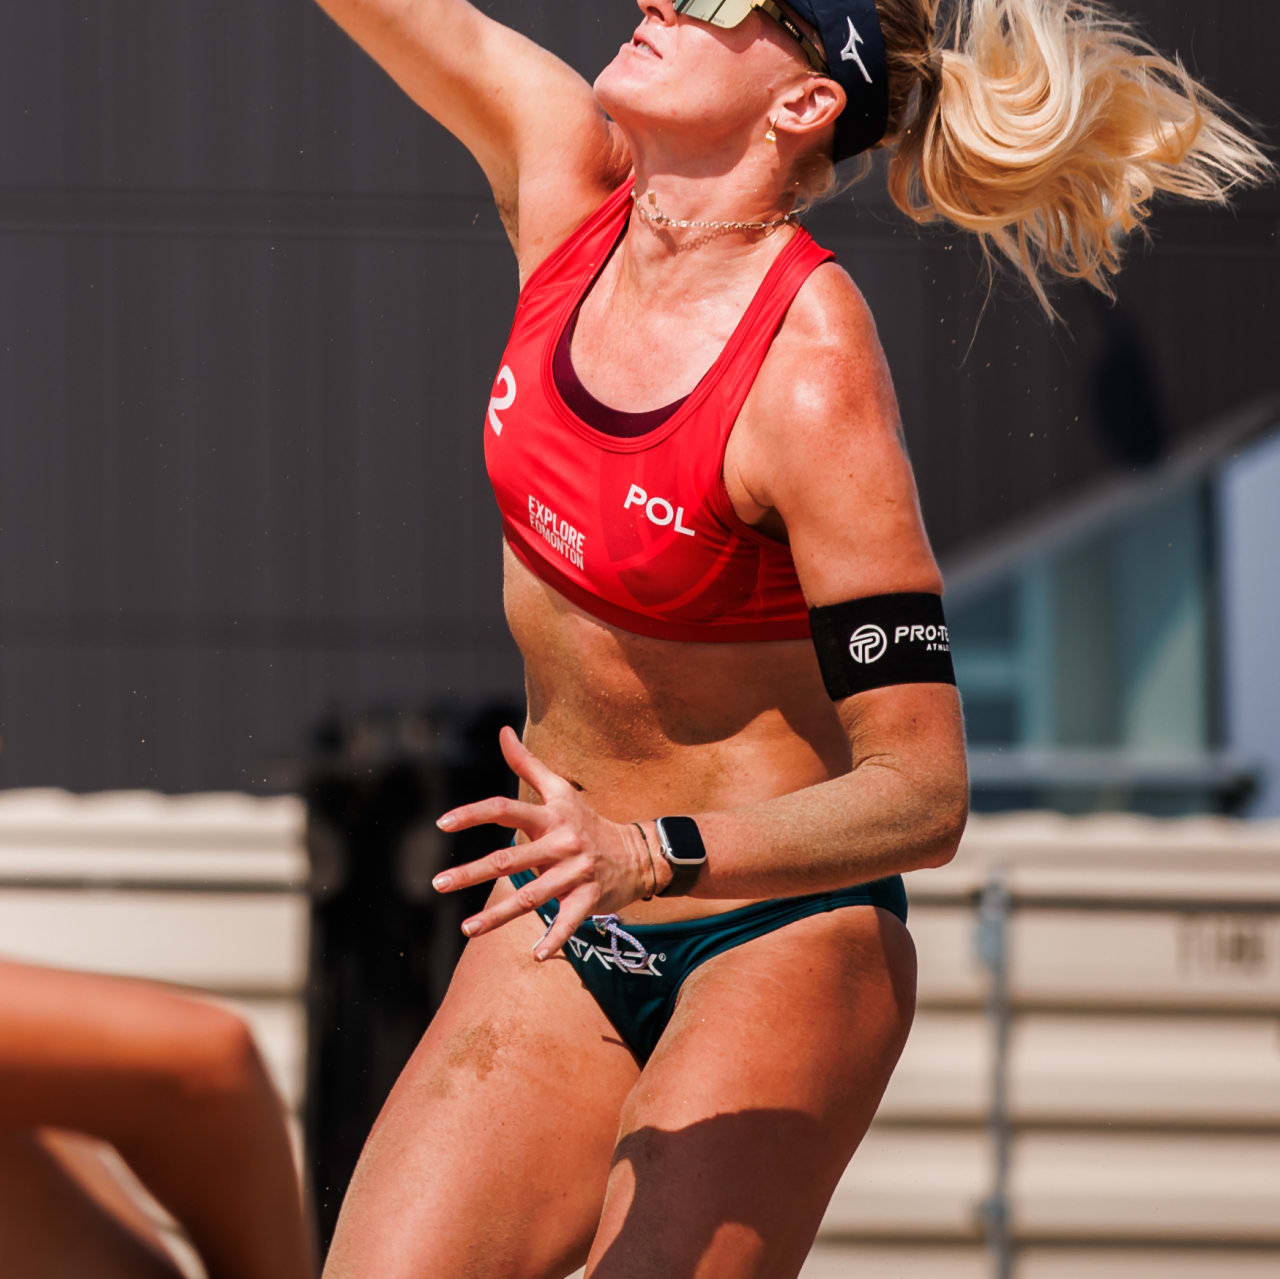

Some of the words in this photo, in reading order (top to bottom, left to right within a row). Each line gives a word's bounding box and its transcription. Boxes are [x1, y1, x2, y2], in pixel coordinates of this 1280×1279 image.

[528, 494, 586, 555] EXPLORE
[623, 483, 696, 537] POL
[528, 514, 585, 572] EDMONTON
